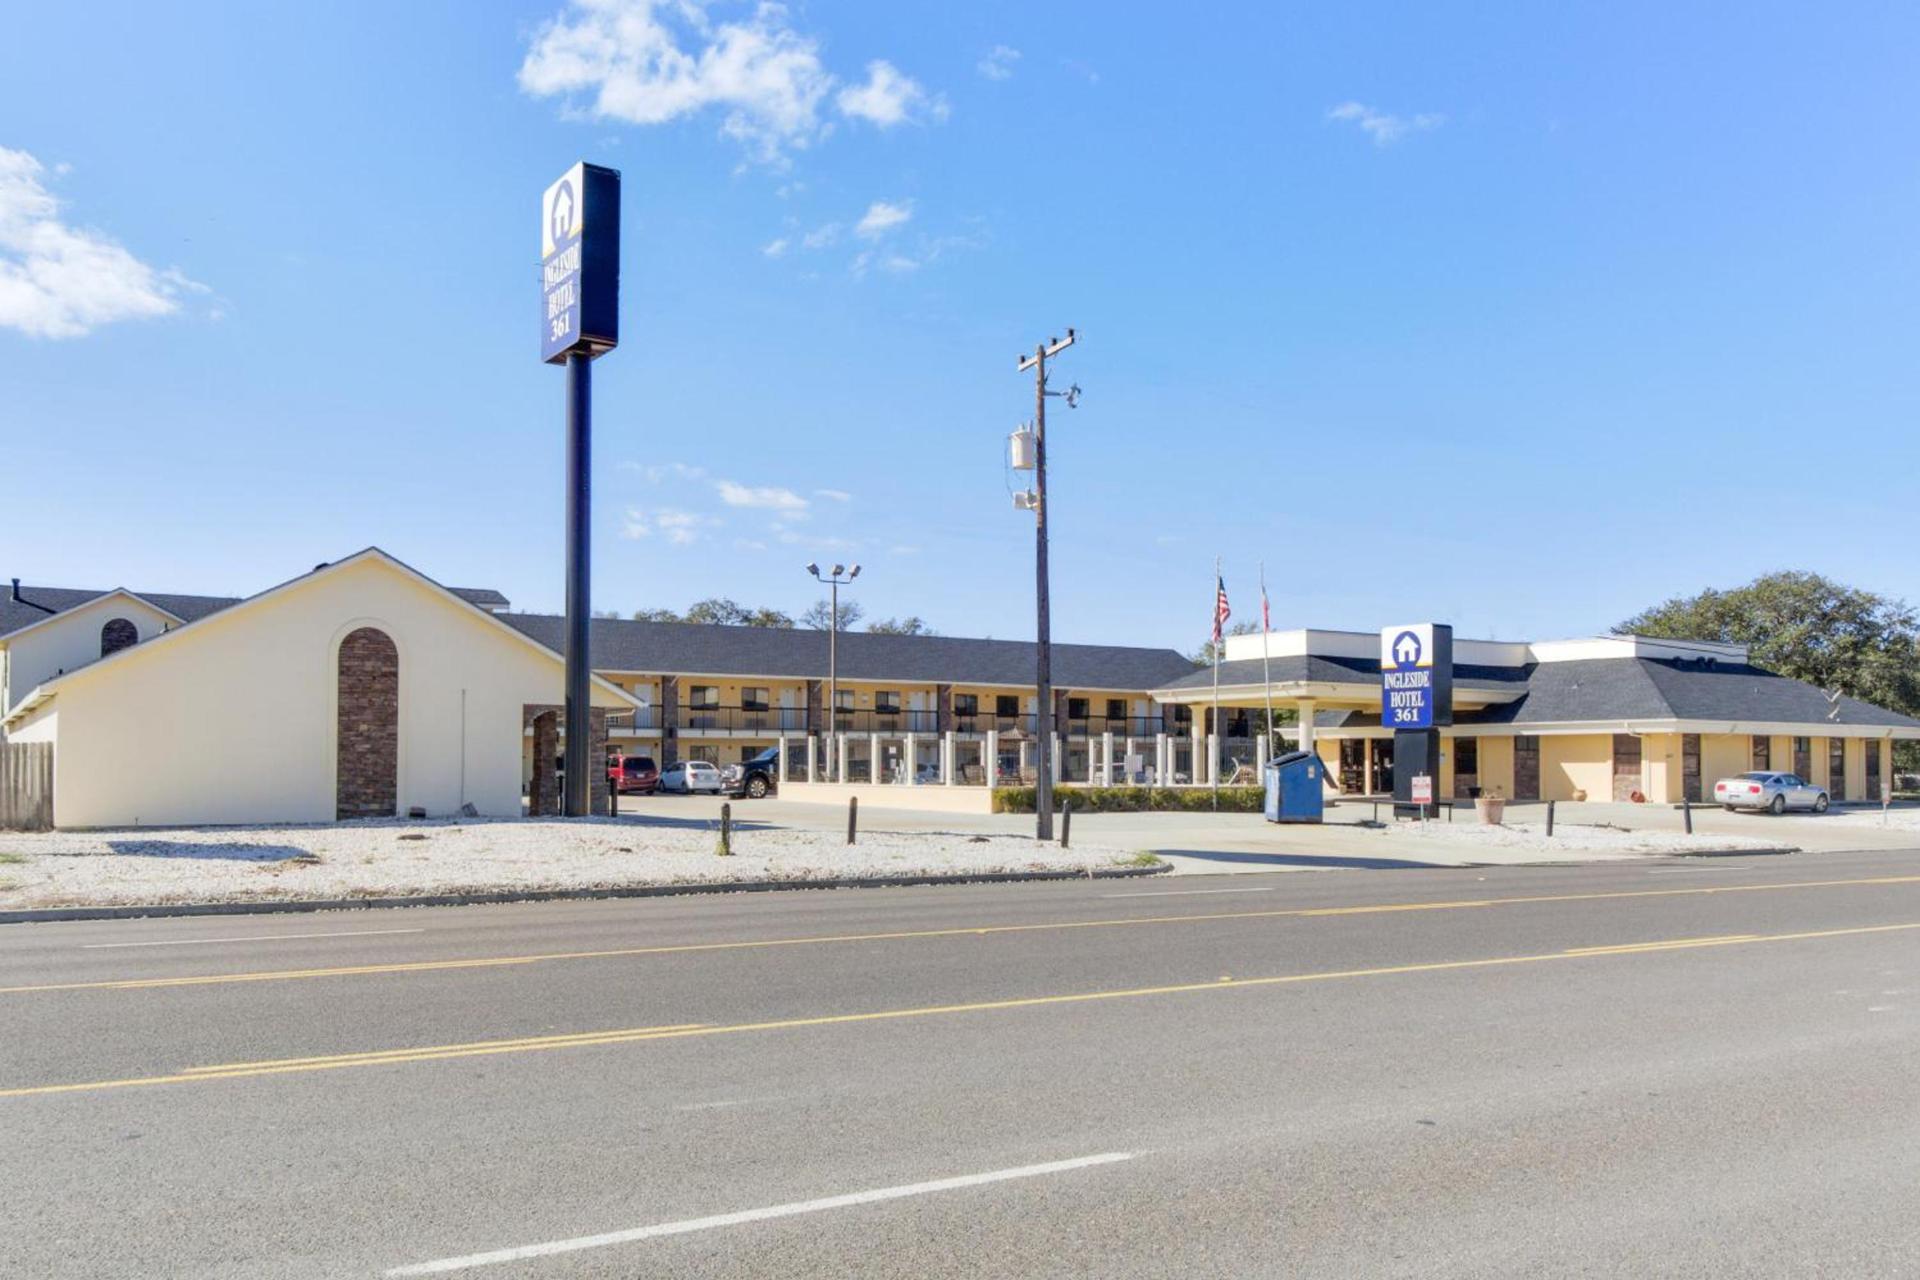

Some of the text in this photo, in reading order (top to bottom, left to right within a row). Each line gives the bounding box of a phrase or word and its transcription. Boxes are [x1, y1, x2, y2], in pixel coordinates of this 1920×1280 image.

[551, 312, 571, 342] 361
[1384, 671, 1430, 689] INGLESIDE
[1391, 690, 1424, 707] HOTEL
[1394, 708, 1419, 722] 361
